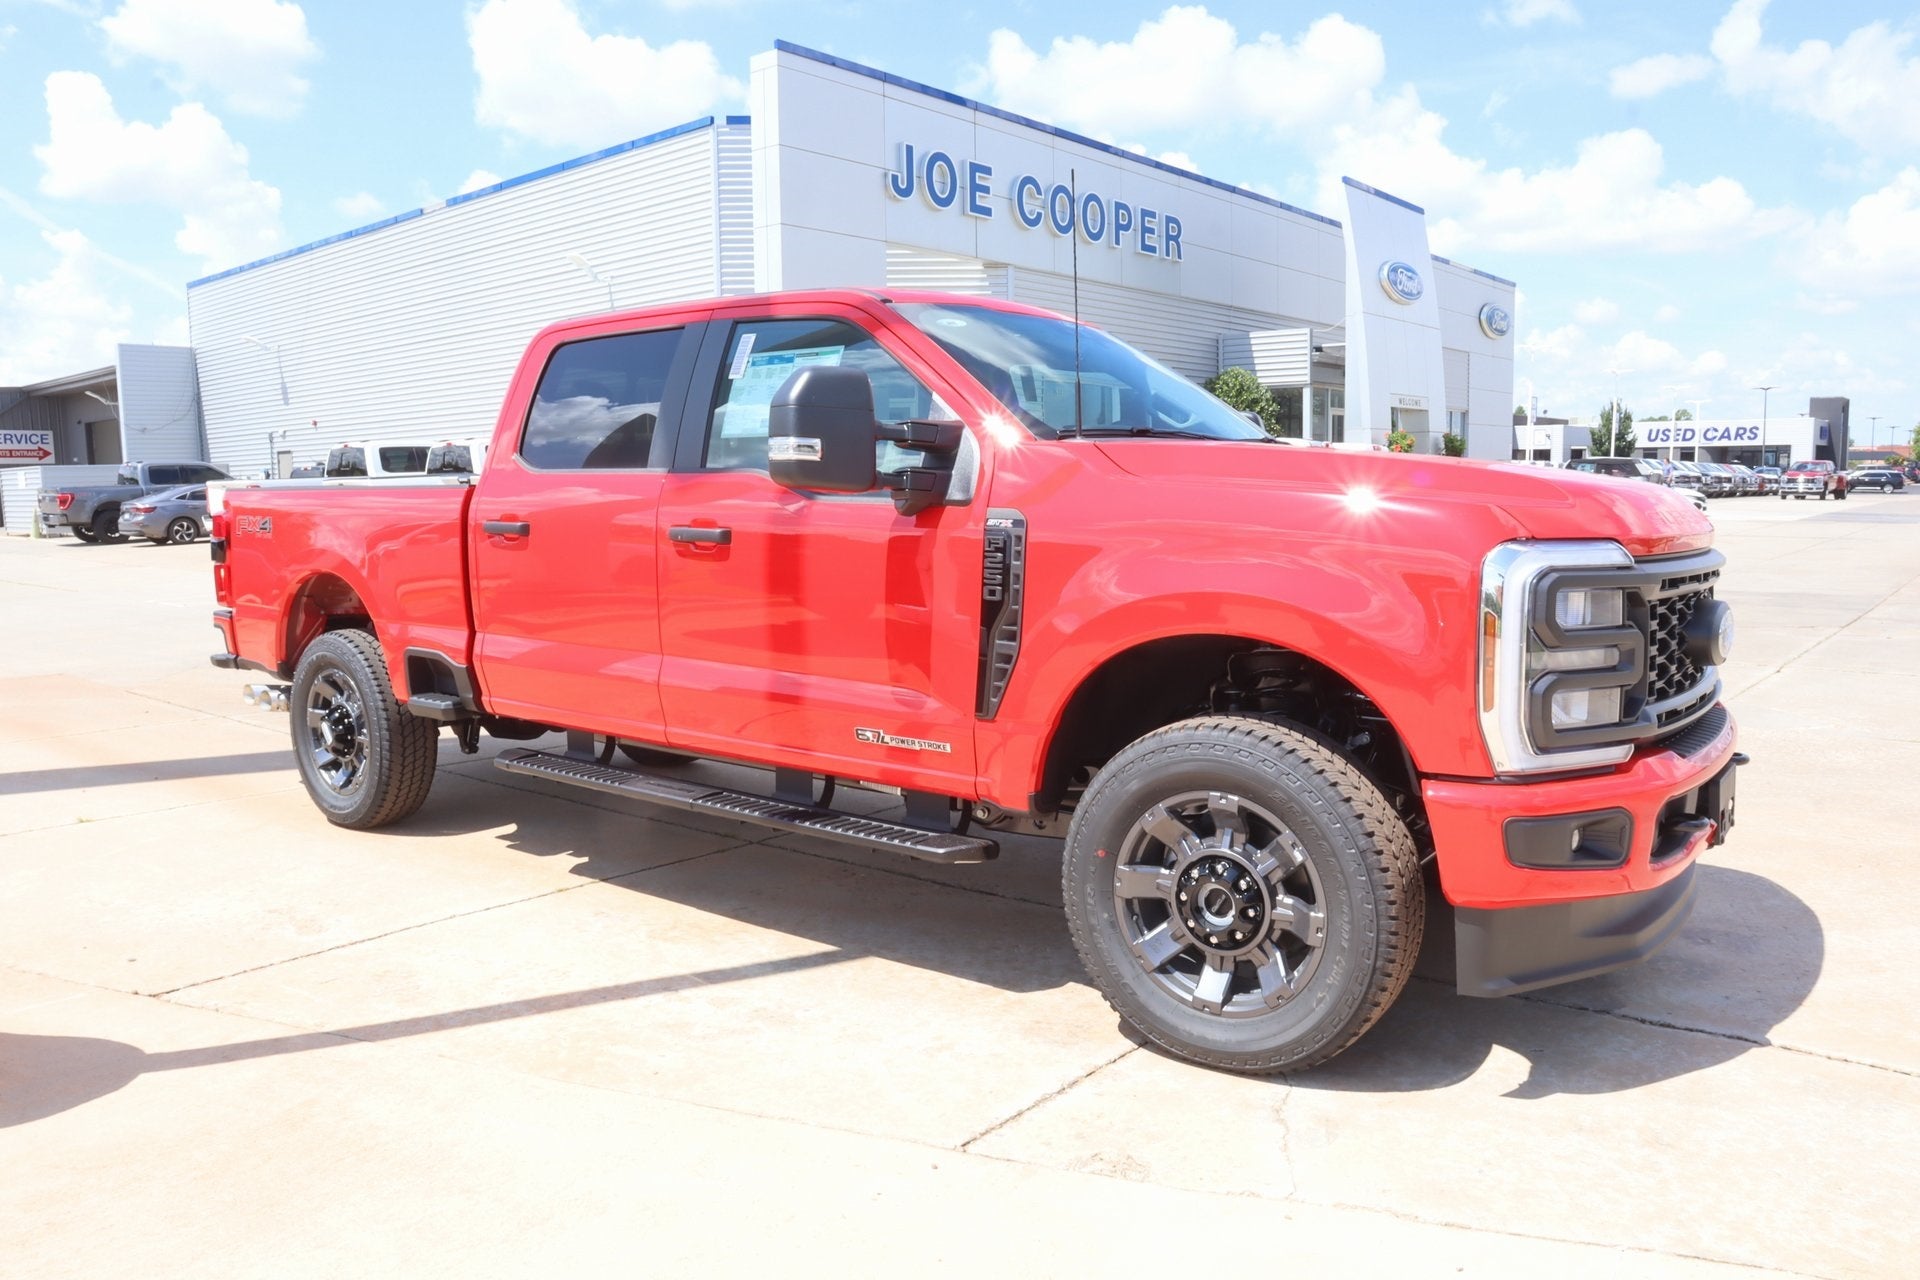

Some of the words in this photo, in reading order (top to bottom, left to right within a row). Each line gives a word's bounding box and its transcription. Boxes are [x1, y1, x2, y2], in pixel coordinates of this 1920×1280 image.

[889, 142, 994, 219] JOE
[1012, 172, 1184, 262] COOPER
[1398, 397, 1421, 408] WELCOME
[0, 433, 50, 445] RVICE
[1647, 427, 1696, 443] USED
[1702, 426, 1760, 443] CARS
[236, 515, 272, 536] FX4
[855, 728, 890, 745] 6.7L
[889, 736, 917, 748] POWER
[917, 740, 949, 752] STROKE
